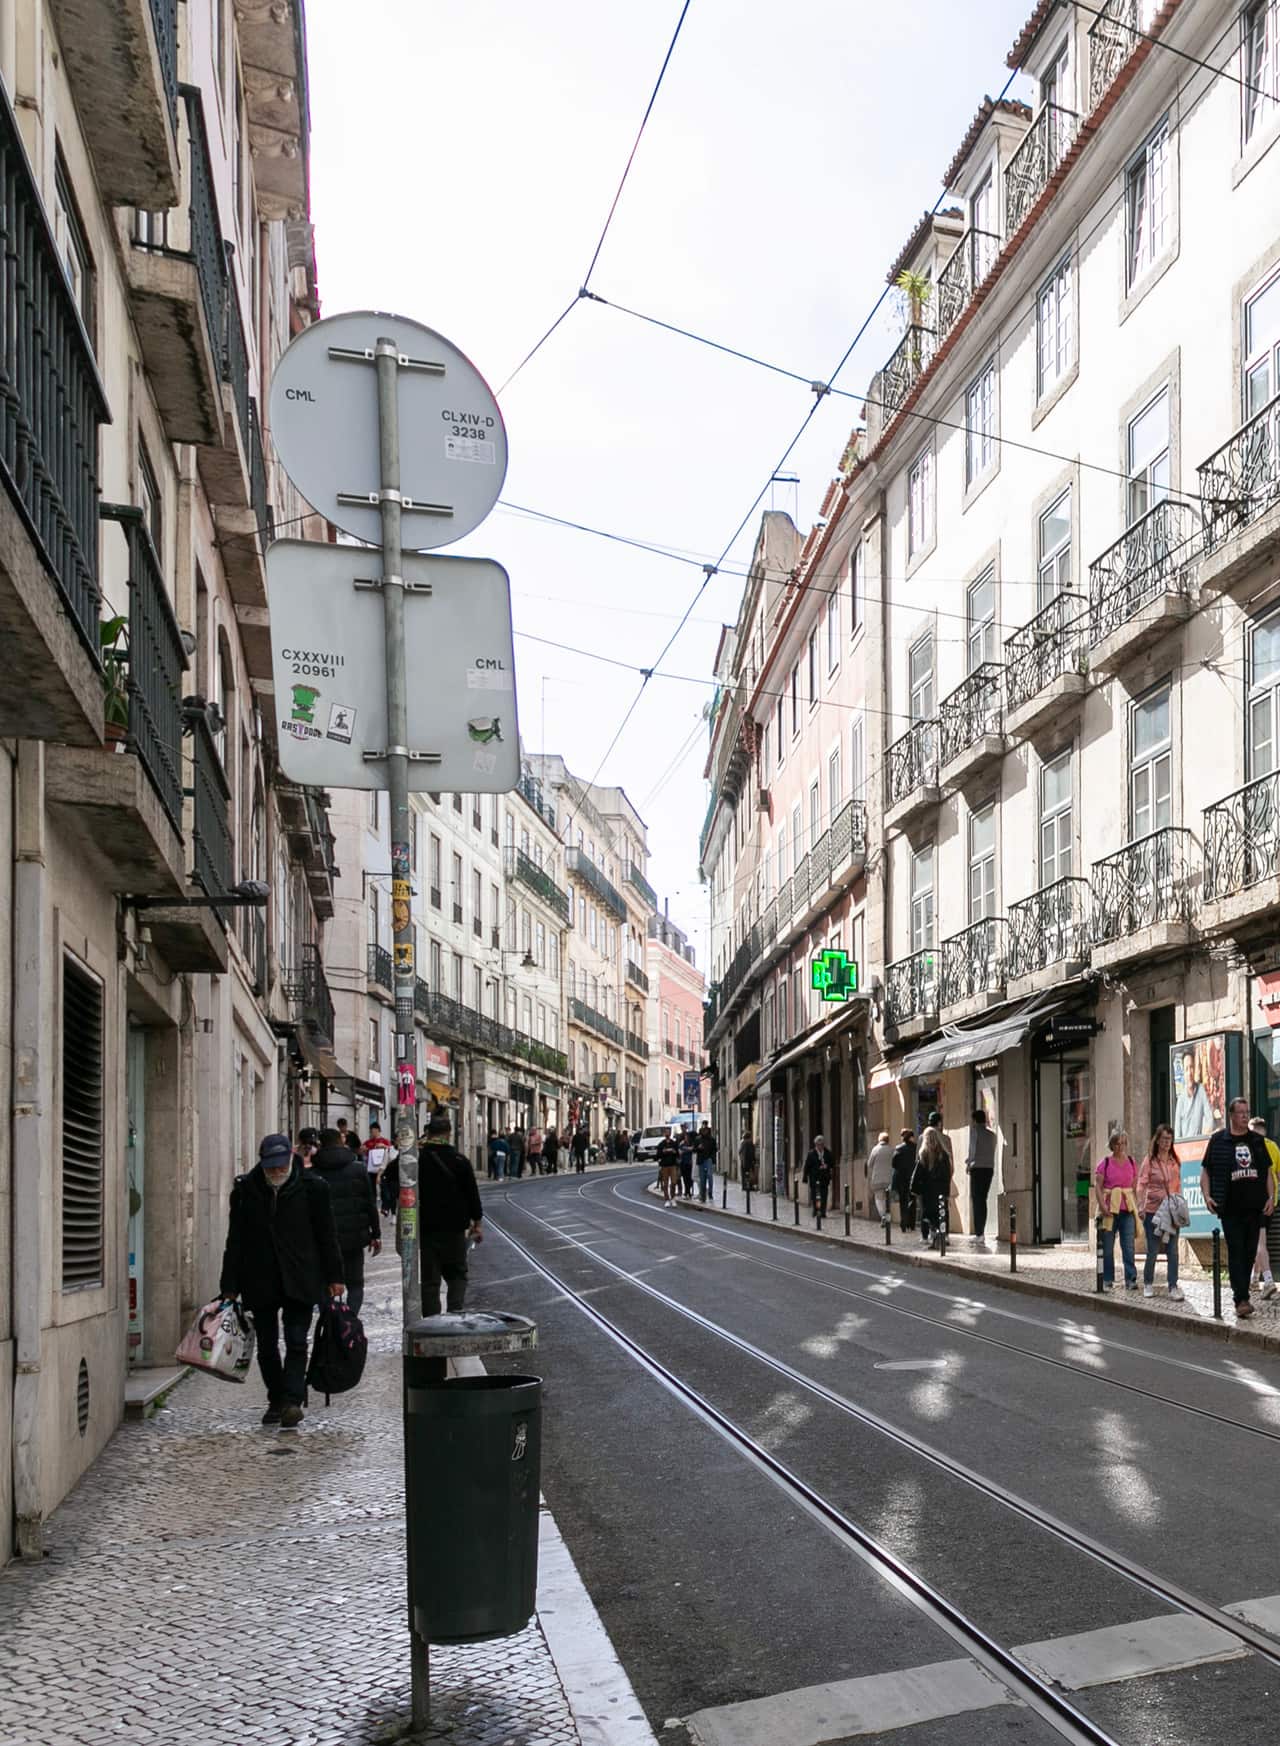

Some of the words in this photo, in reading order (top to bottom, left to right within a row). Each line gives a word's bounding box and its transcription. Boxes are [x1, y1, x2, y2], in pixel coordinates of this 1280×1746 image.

[285, 388, 316, 402] CML
[441, 410, 495, 428] CLXIV-D
[452, 425, 486, 440] 3238
[281, 648, 345, 666] CXXXVIII
[475, 658, 505, 670] CML
[292, 663, 336, 677] 20961
